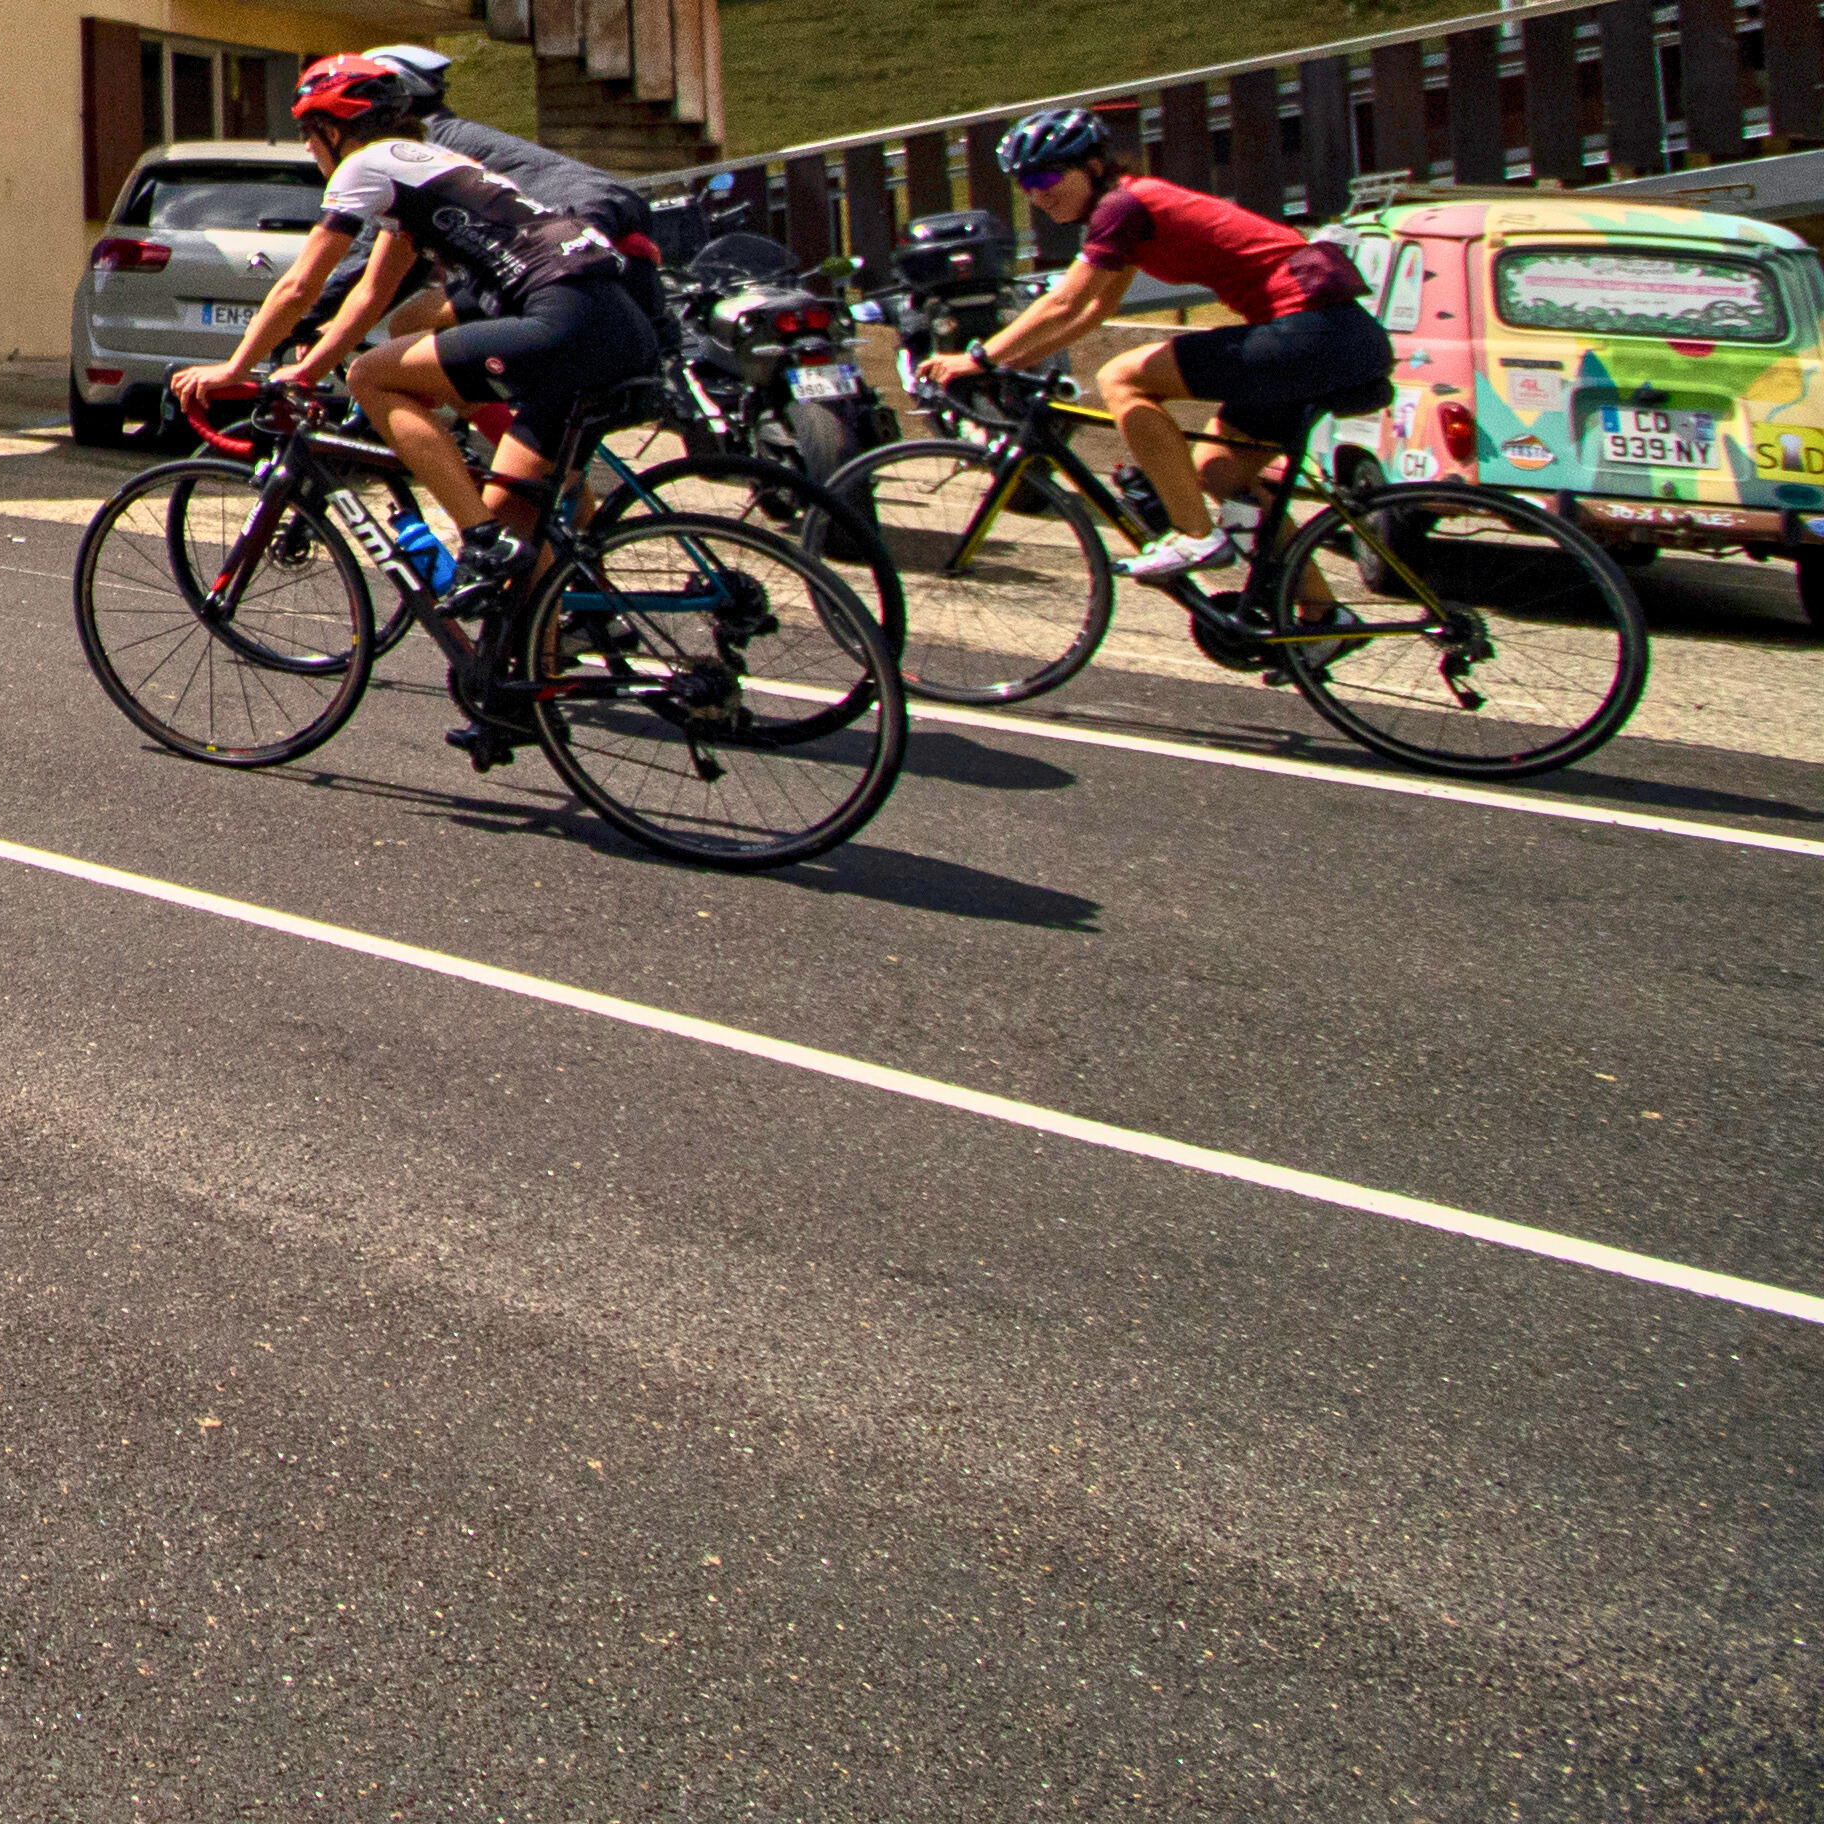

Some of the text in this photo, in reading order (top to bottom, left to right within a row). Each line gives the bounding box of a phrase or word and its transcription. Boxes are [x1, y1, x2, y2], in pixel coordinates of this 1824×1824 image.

[1610, 434, 1711, 465] 939-NY
[1405, 453, 1427, 479] CH
[327, 489, 422, 592] BMC
